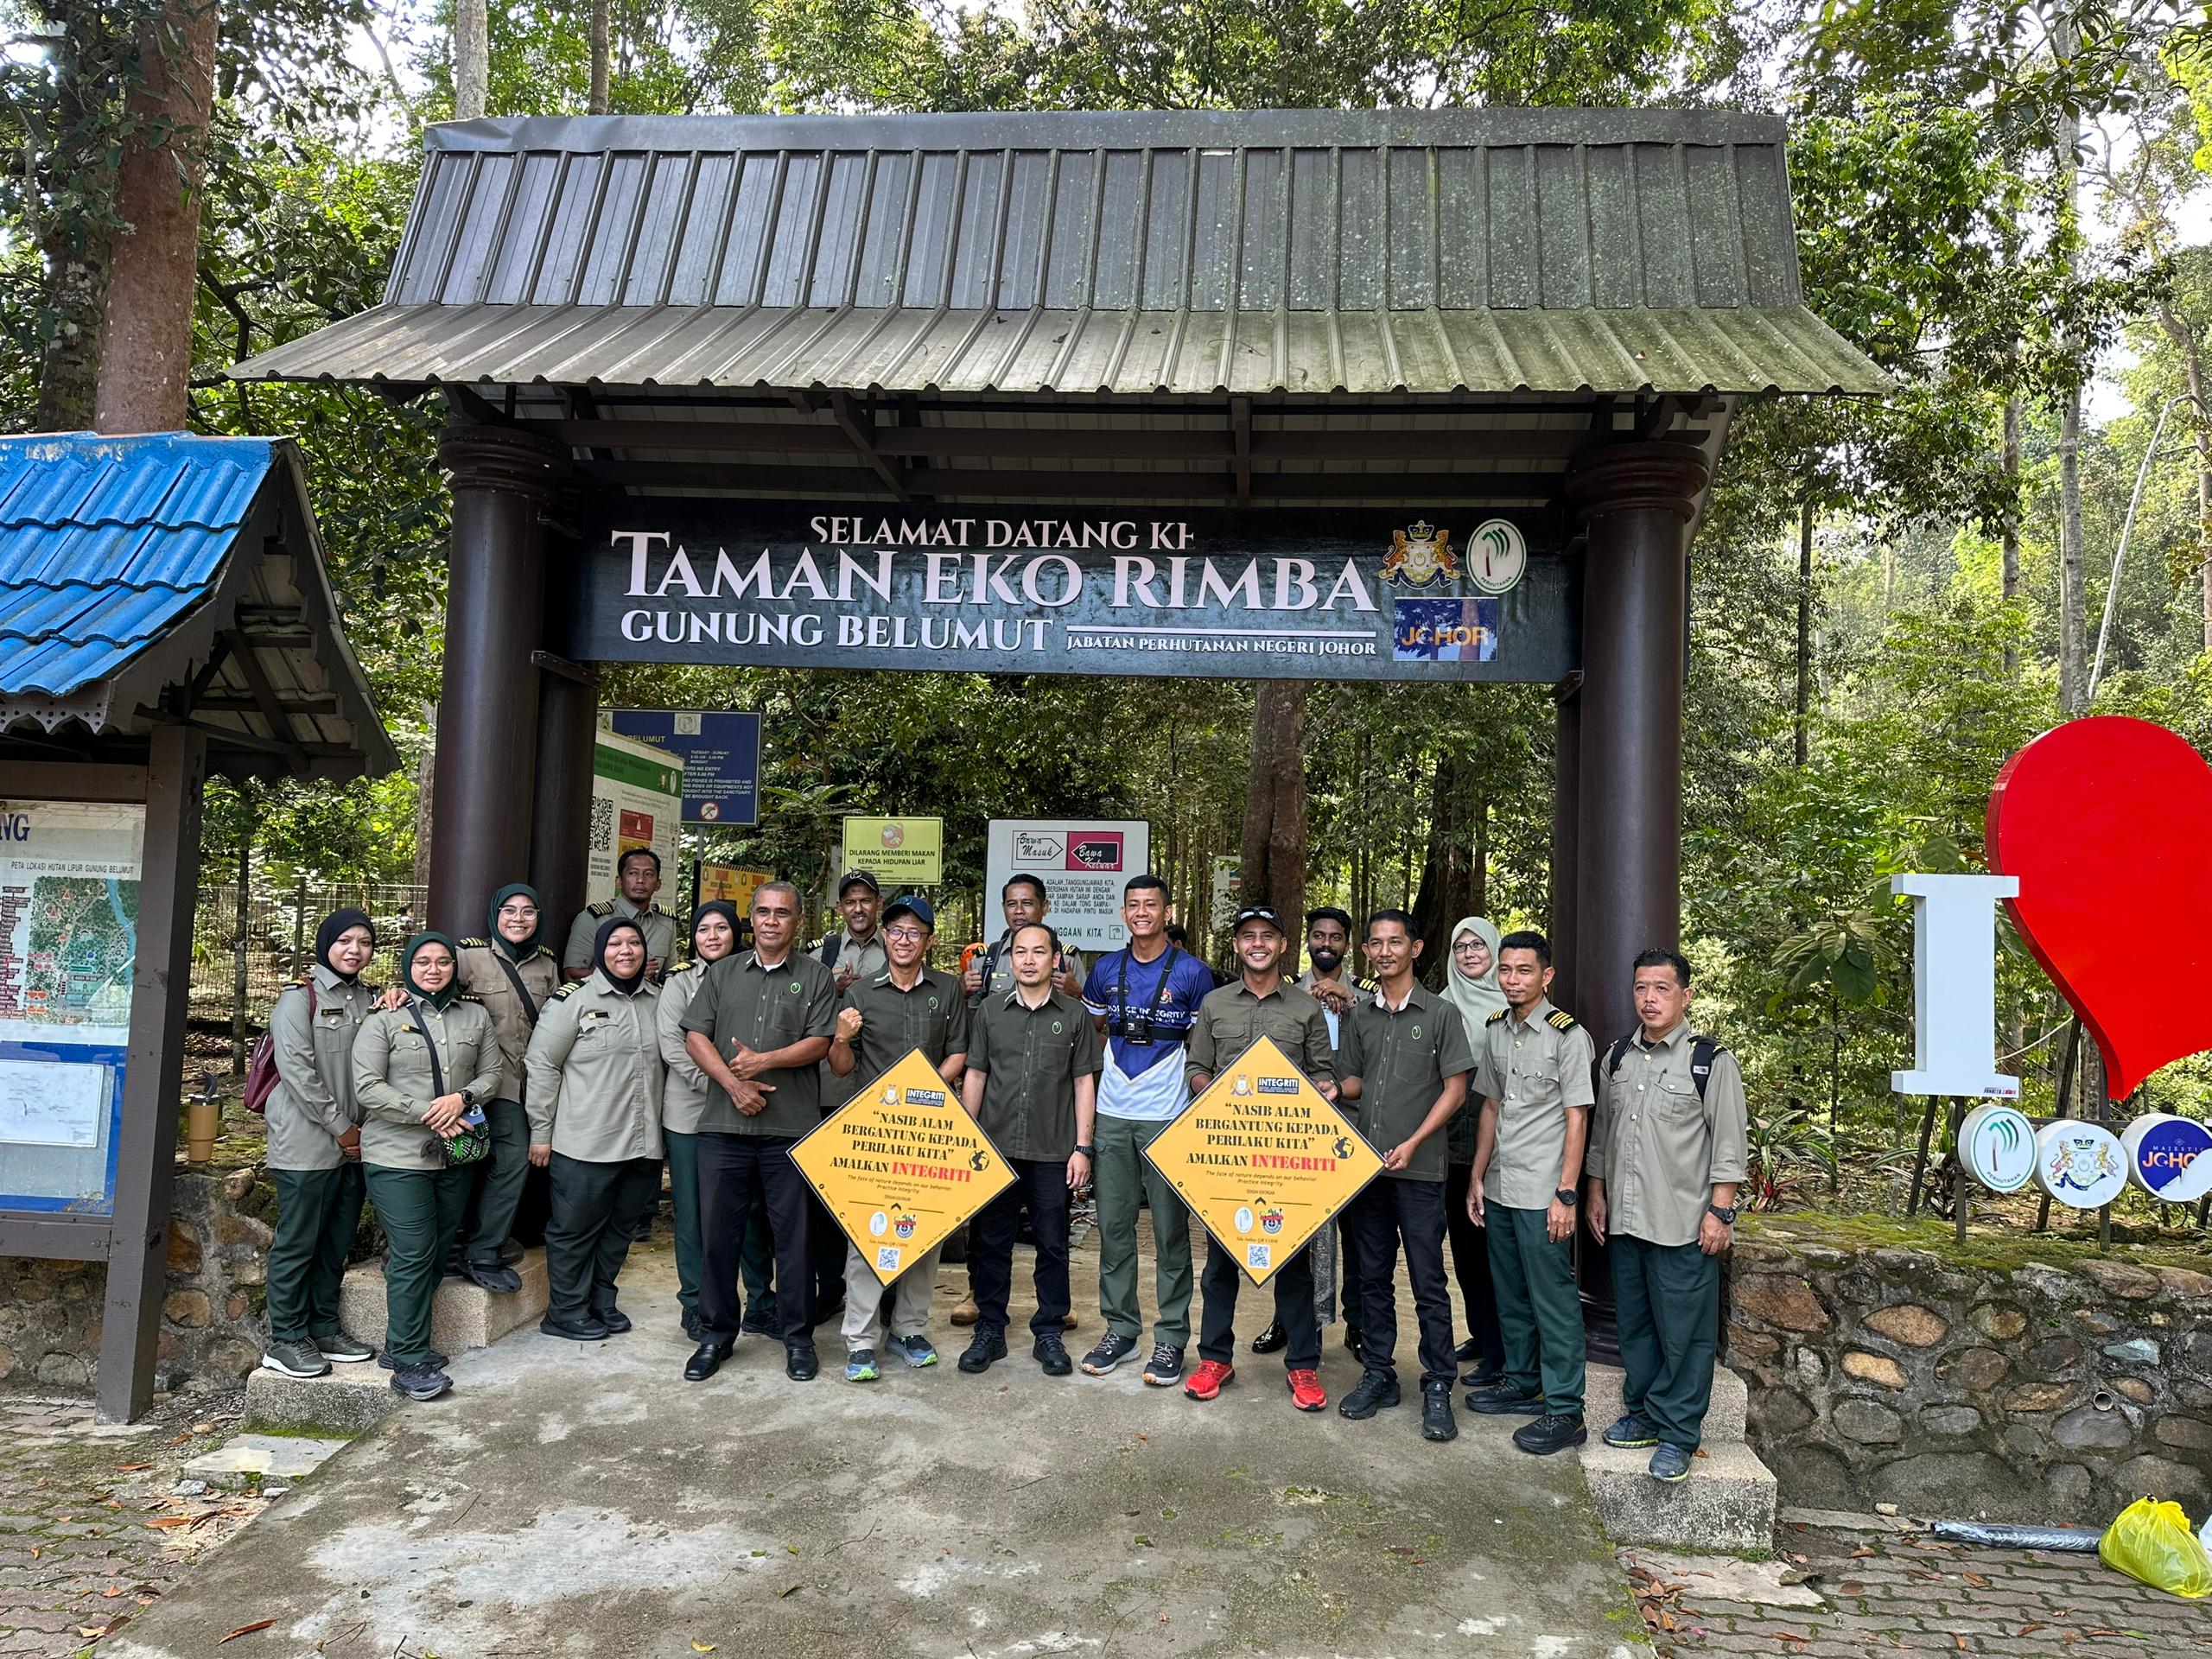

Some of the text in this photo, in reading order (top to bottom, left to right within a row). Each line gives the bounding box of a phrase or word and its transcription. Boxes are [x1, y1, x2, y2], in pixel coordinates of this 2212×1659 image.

[810, 516, 976, 547] SELAMAT
[986, 519, 1139, 550] DATANG
[611, 530, 1380, 612] TAMAN EKO RIMBA
[1480, 576, 1512, 588] PERHUTANAN
[620, 609, 1053, 652] GUNUNG BELUMUT
[1066, 636, 1376, 656] JABATAN PERHUTANAN NEGERI JOHOR
[1020, 832, 1042, 844] Bawa
[1022, 845, 1052, 856] Masuk
[1078, 845, 1103, 857] Bawa
[26, 862, 46, 871] LOKASI
[48, 863, 66, 872] HUTAN
[85, 865, 107, 874] GUNUNG
[109, 866, 134, 874] BELUMUT
[1084, 856, 1115, 869] Keluar
[1053, 927, 1082, 938] NGGAAN
[1258, 1077, 1298, 1088] INTEGRITI
[907, 1089, 944, 1100] INTEGRITI
[1274, 1106, 1311, 1118] ALAM
[920, 1117, 954, 1131] ALAM
[1195, 1118, 1339, 1135] BERGANTUNG KEPADA
[842, 1123, 977, 1149] BERGANTUNG KEPADA
[1206, 1134, 1273, 1147] PERILAKU
[851, 1140, 915, 1157] PERILAKU
[1185, 1153, 1337, 1172] AMALKAN INTEGRITI
[830, 1156, 971, 1183] AMALKAN INTEGRITI
[1986, 1171, 2022, 1184] PERHUTANAN
